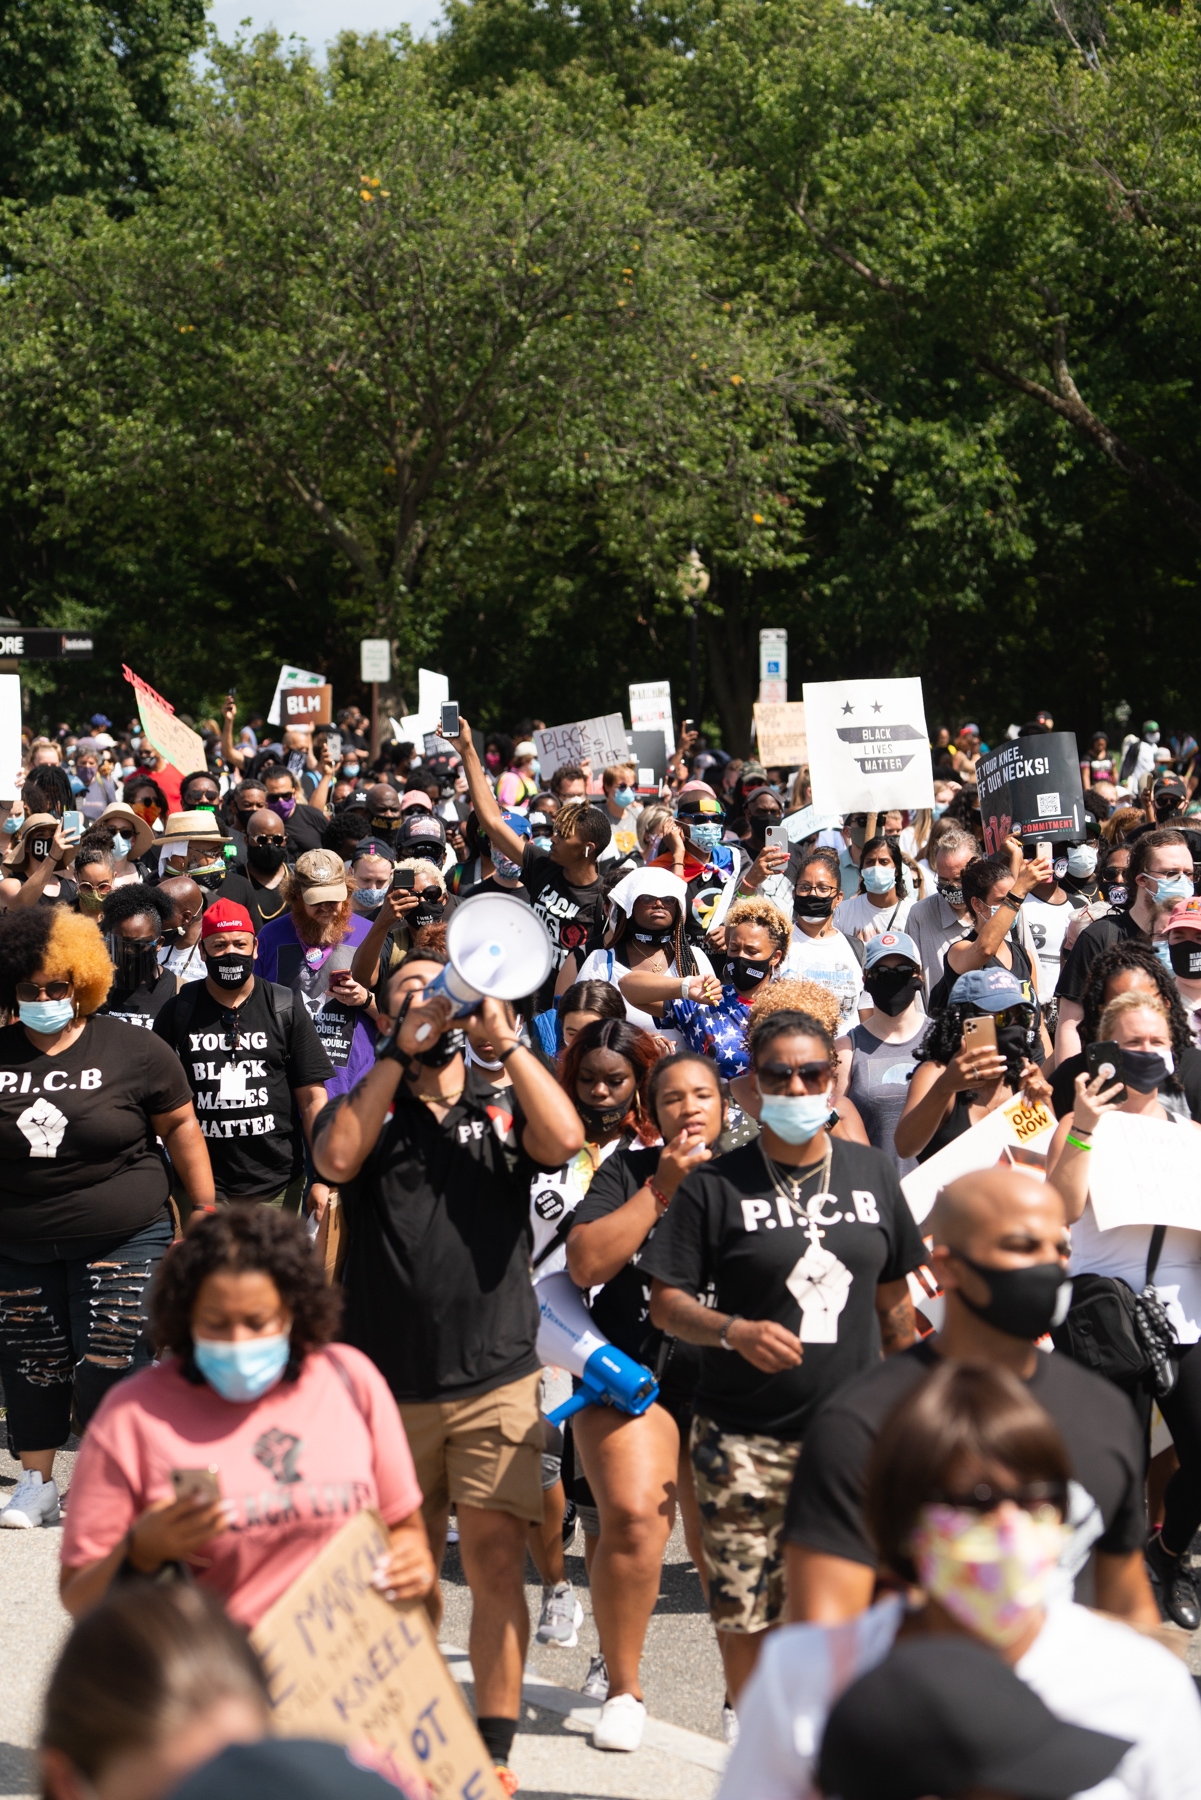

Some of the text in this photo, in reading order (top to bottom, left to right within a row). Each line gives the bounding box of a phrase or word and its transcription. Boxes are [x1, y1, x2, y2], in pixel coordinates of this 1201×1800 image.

[287, 695, 321, 715] BLM
[540, 725, 591, 754] BLACK
[862, 728, 892, 740] BLACK
[556, 738, 604, 761] LIVES
[864, 743, 893, 755] LIVES
[864, 758, 903, 771] MATTER
[982, 757, 997, 777] YOUR
[999, 746, 1023, 767] KNEE,
[987, 770, 1002, 793] OUR
[1002, 757, 1050, 783] NECKS!
[1022, 819, 1073, 833] COMMITMENT
[218, 964, 244, 974] BREONNA
[220, 972, 242, 981] TAYLOR
[189, 1032, 268, 1052] YOUNG
[1012, 1104, 1039, 1126] OUT
[1016, 1111, 1049, 1140] NOW
[740, 1189, 880, 1232] P.I.C.B
[331, 1617, 423, 1724] KNEEL
